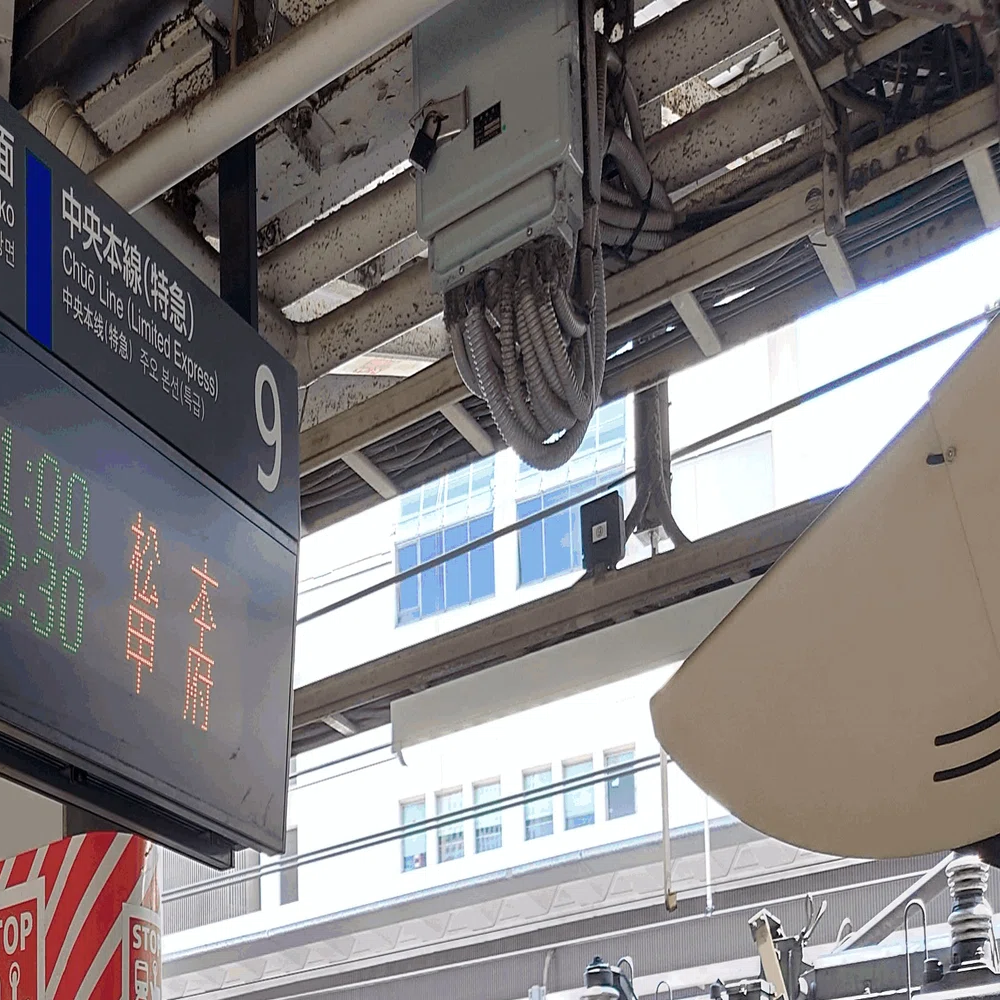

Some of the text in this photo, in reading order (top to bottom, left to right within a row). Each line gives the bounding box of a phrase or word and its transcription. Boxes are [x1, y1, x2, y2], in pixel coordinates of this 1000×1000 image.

[61, 186, 195, 342] 中央本線(特急)
[61, 285, 133, 364] 中央本线(特急)
[62, 245, 219, 402] Chūō Line (Limited Express)
[139, 347, 159, 382] 주오
[253, 364, 283, 493] 9
[129, 511, 219, 652] 松本
[126, 604, 215, 732] 甲府
